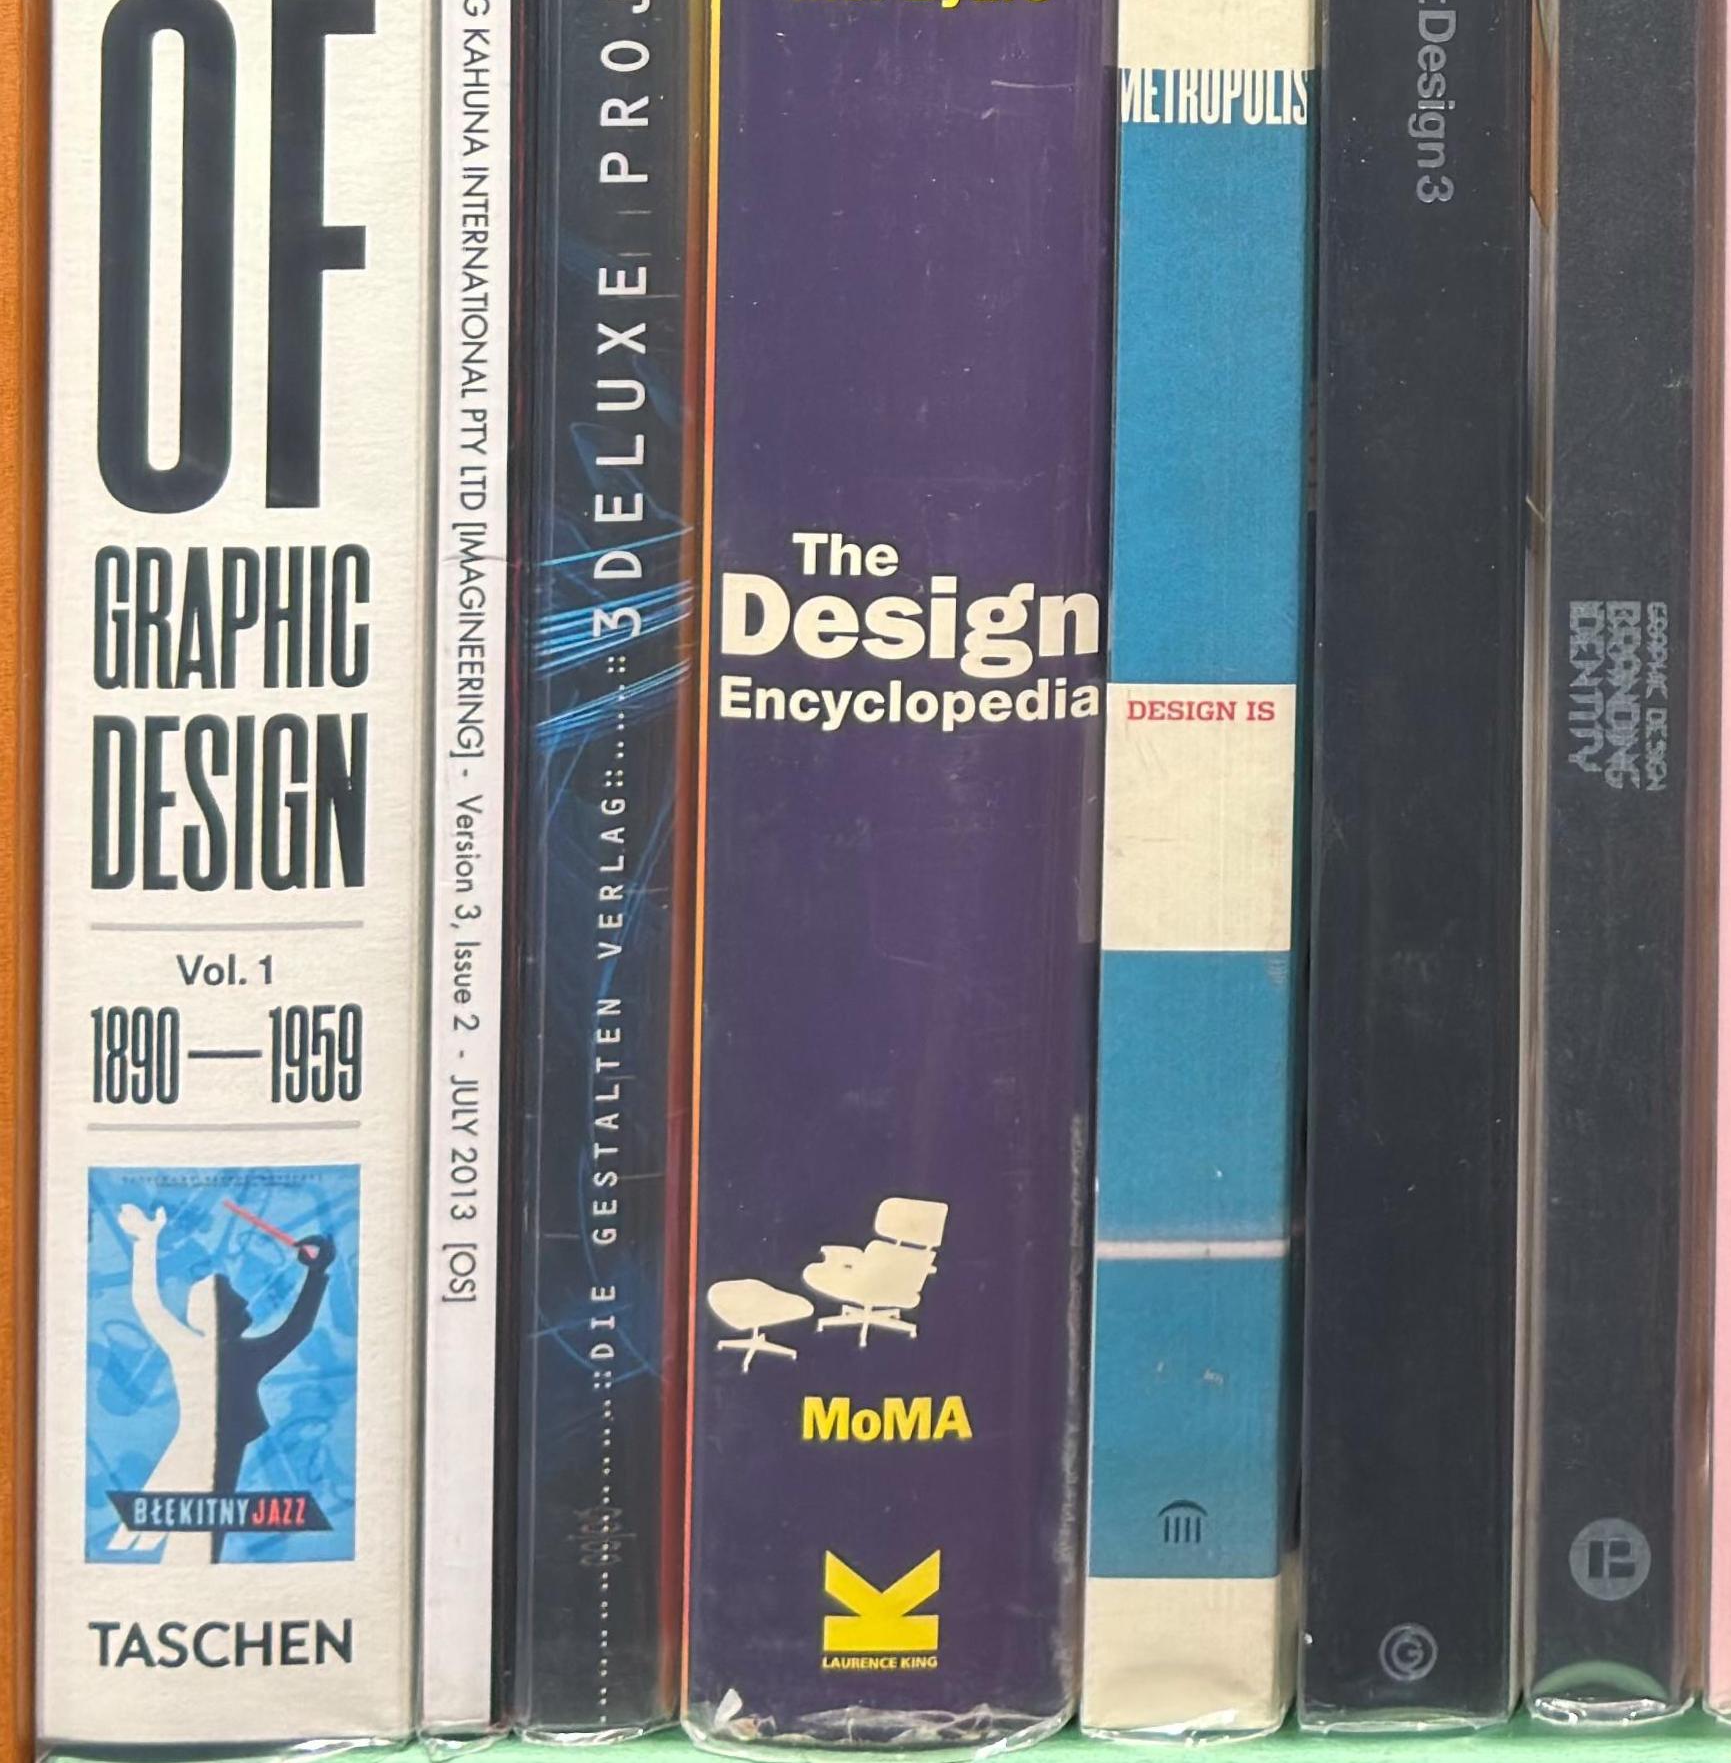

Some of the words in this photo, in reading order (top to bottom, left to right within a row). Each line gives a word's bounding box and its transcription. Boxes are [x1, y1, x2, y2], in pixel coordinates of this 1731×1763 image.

[463, 28, 490, 155] KAHUNA
[460, 169, 488, 398] INTERNATIONAL
[460, 408, 488, 456] PTY
[459, 468, 487, 511] LTD
[792, 533, 899, 576] The
[93, 542, 371, 692] GRAPHIC
[452, 520, 487, 755] [IMAGINEERING]
[721, 572, 1100, 677] Design
[719, 676, 1100, 732] Encyclopedia
[1127, 699, 1235, 722] DESIGN
[1246, 699, 1275, 722] IS
[90, 710, 370, 893] DESIGN
[456, 796, 481, 894] Version
[597, 798, 626, 960] VERLAG
[176, 954, 251, 987] Vol.
[259, 954, 276, 987] 1
[456, 941, 481, 1005] Issue
[455, 1014, 480, 1032] 2
[450, 1073, 480, 1134] JULY
[593, 998, 622, 1243] GESTALTEN
[450, 1147, 478, 1219] 2013
[445, 1241, 478, 1305] [OS]
[590, 1285, 616, 1359] DIE
[802, 1395, 972, 1441] MoMA
[252, 1497, 307, 1524] JAZZ
[88, 1618, 352, 1668] TASCHEN
[822, 1655, 896, 1669] LAURENCE
[901, 1655, 938, 1669] KING
